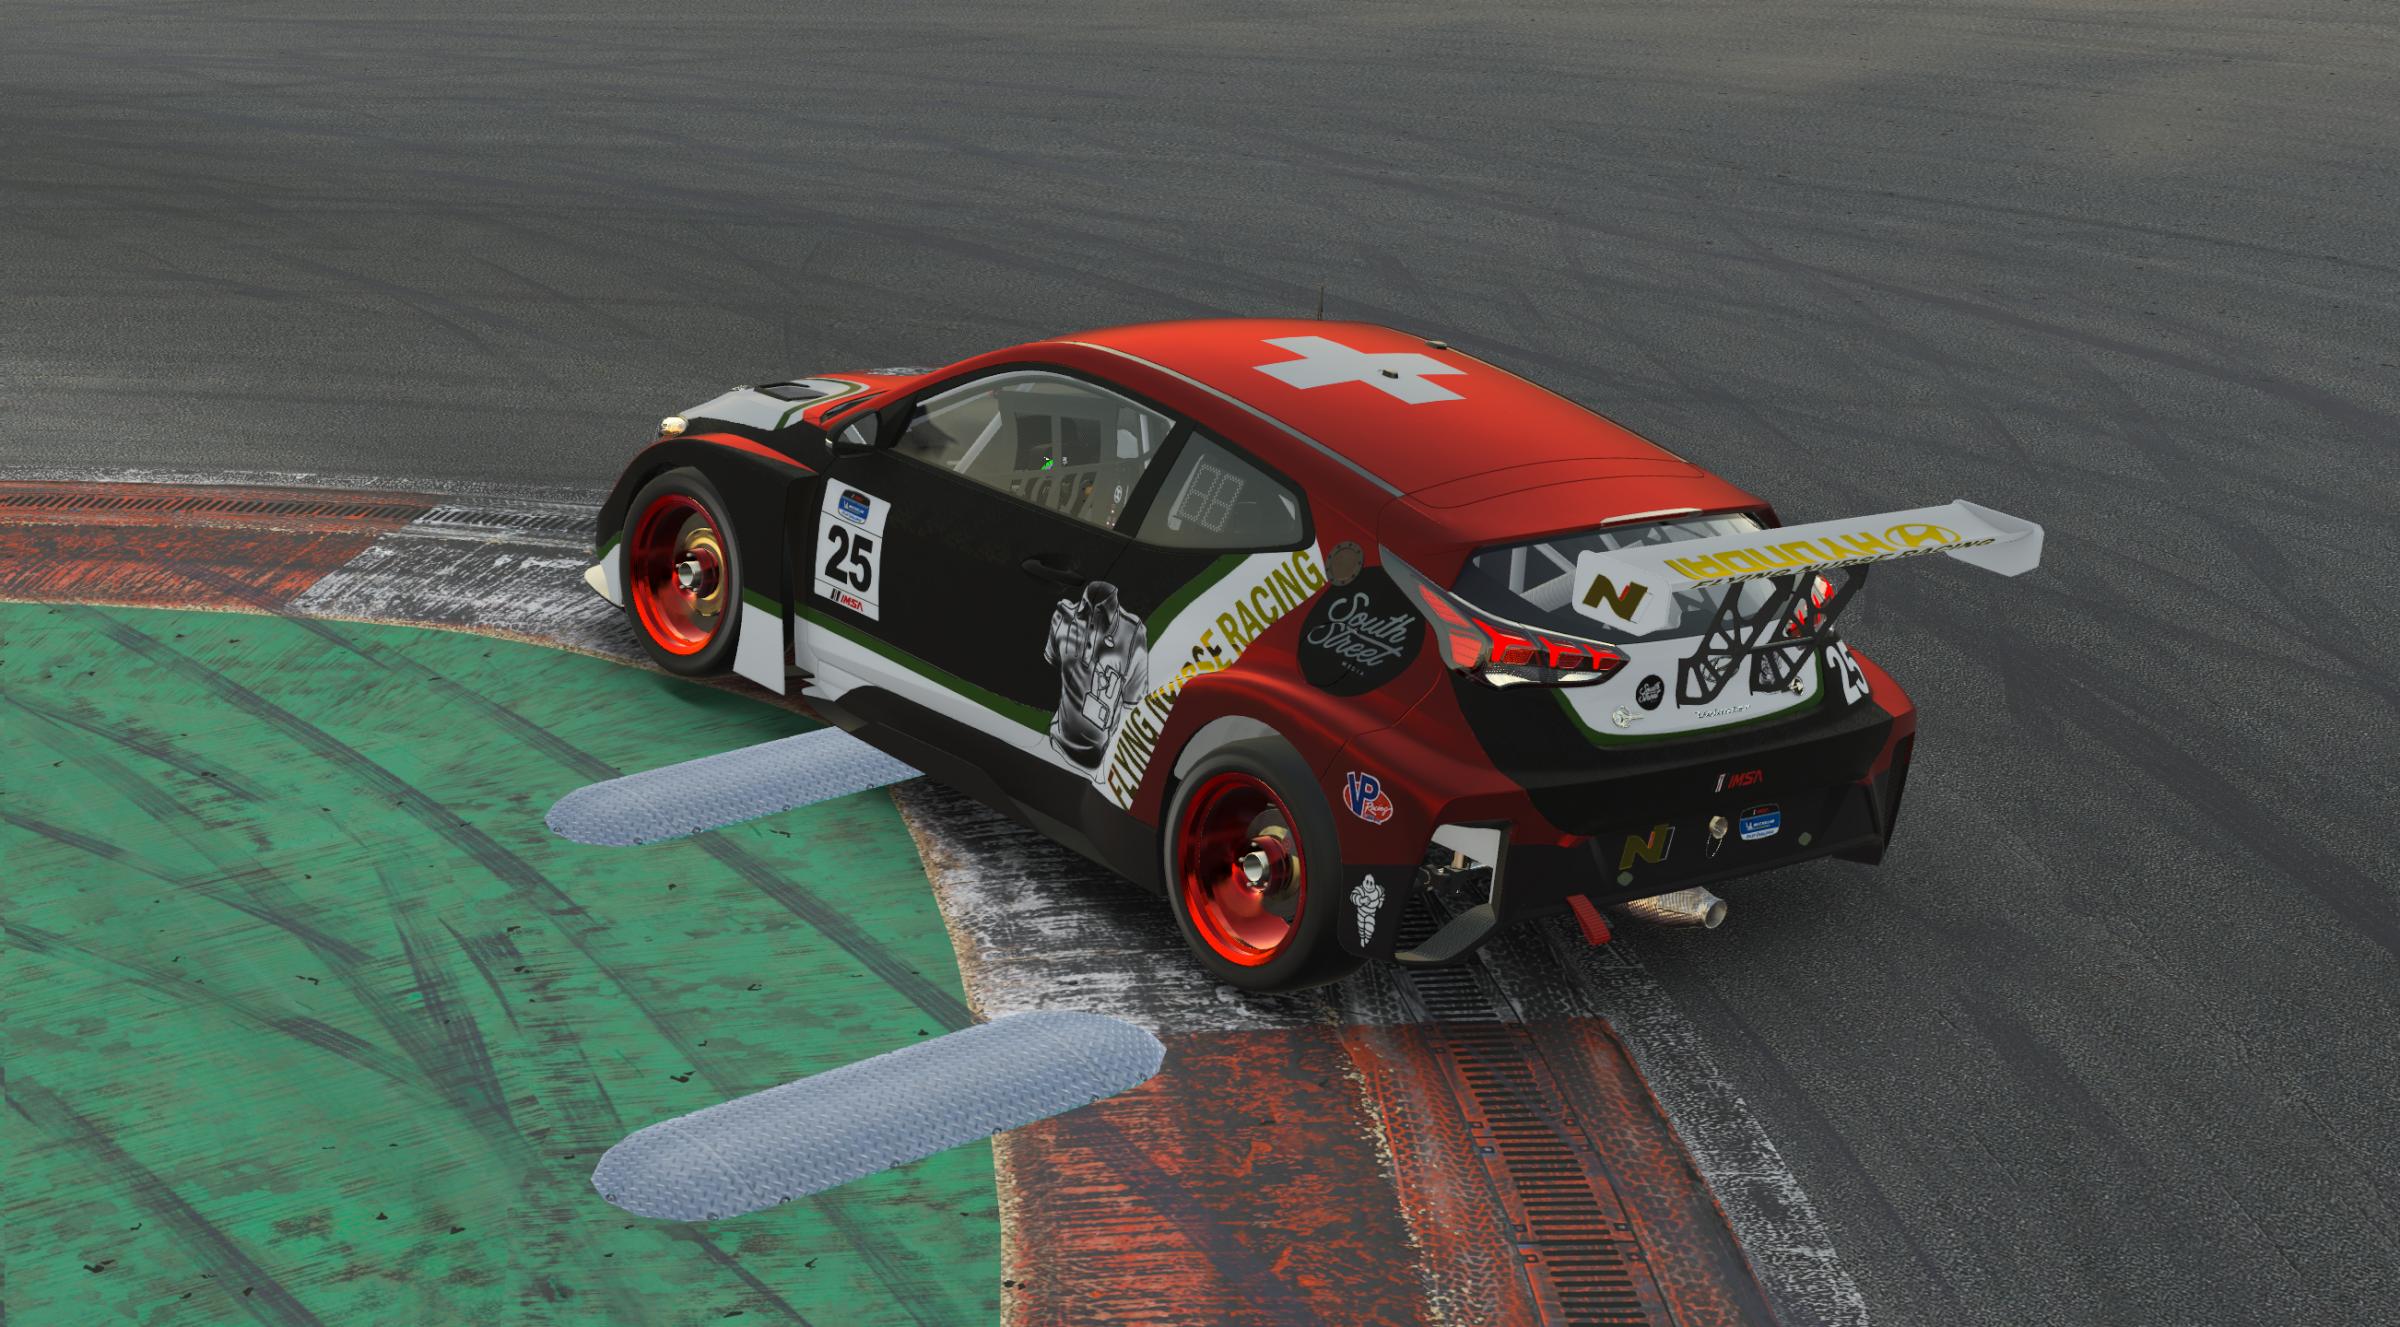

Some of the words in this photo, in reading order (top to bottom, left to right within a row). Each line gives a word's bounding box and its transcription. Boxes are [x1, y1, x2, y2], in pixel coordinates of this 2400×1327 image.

[825, 524, 873, 593] 25
[1663, 531, 1902, 581] HYUNDAI
[840, 594, 863, 612] IMSA
[1328, 592, 1416, 643] South
[1582, 574, 1650, 623] N
[1307, 622, 1404, 666] Street
[1108, 707, 1159, 812] FLYING
[1215, 550, 1326, 658] RACING
[1825, 639, 1870, 706] 25
[1346, 771, 1380, 817] VP
[1727, 769, 1764, 788] IMSA
